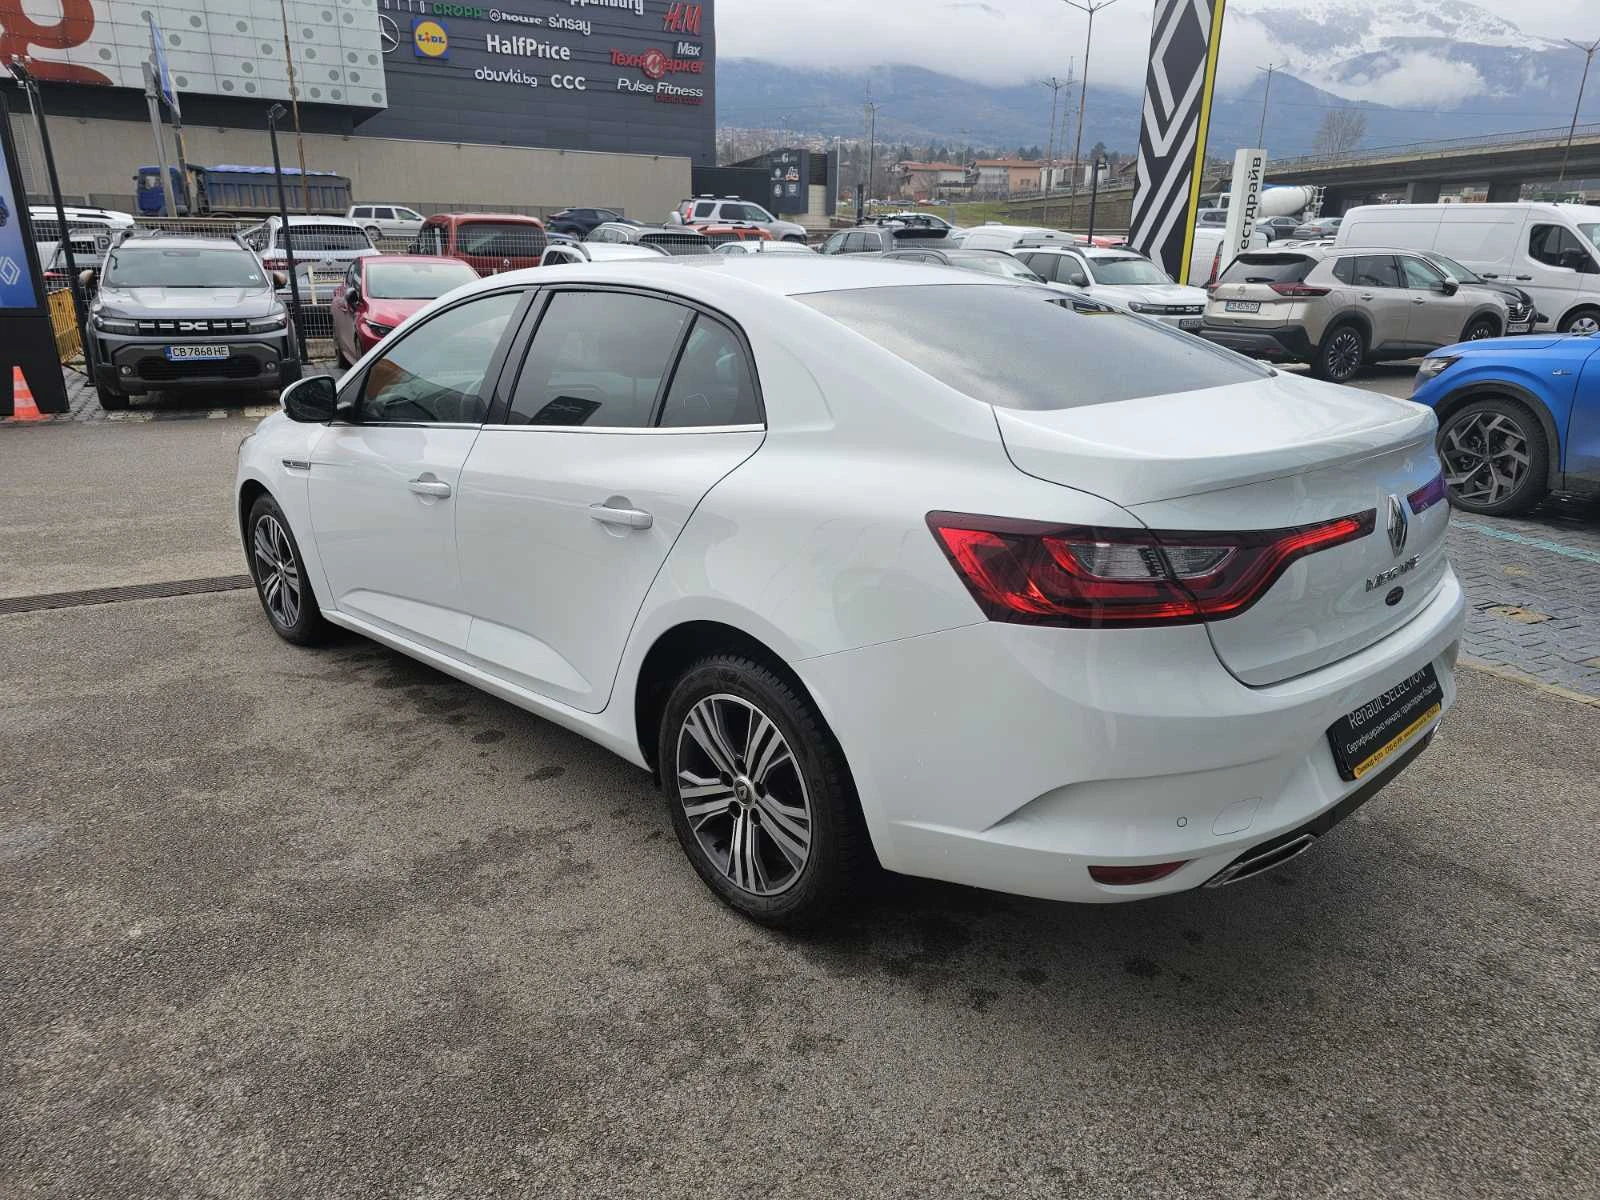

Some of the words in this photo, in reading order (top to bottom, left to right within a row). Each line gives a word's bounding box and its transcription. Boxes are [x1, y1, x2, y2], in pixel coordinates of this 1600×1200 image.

[501, 12, 543, 25] house
[548, 14, 591, 36] sinsay
[486, 34, 571, 60] HalfPrice
[677, 41, 701, 56] Max
[474, 66, 538, 88] obuvki.bg
[551, 74, 586, 91] CCC
[617, 78, 654, 93] Pulse
[656, 82, 704, 97] Fitness
[1238, 157, 1262, 252] естдрайв
[1347, 697, 1385, 729] Renault
